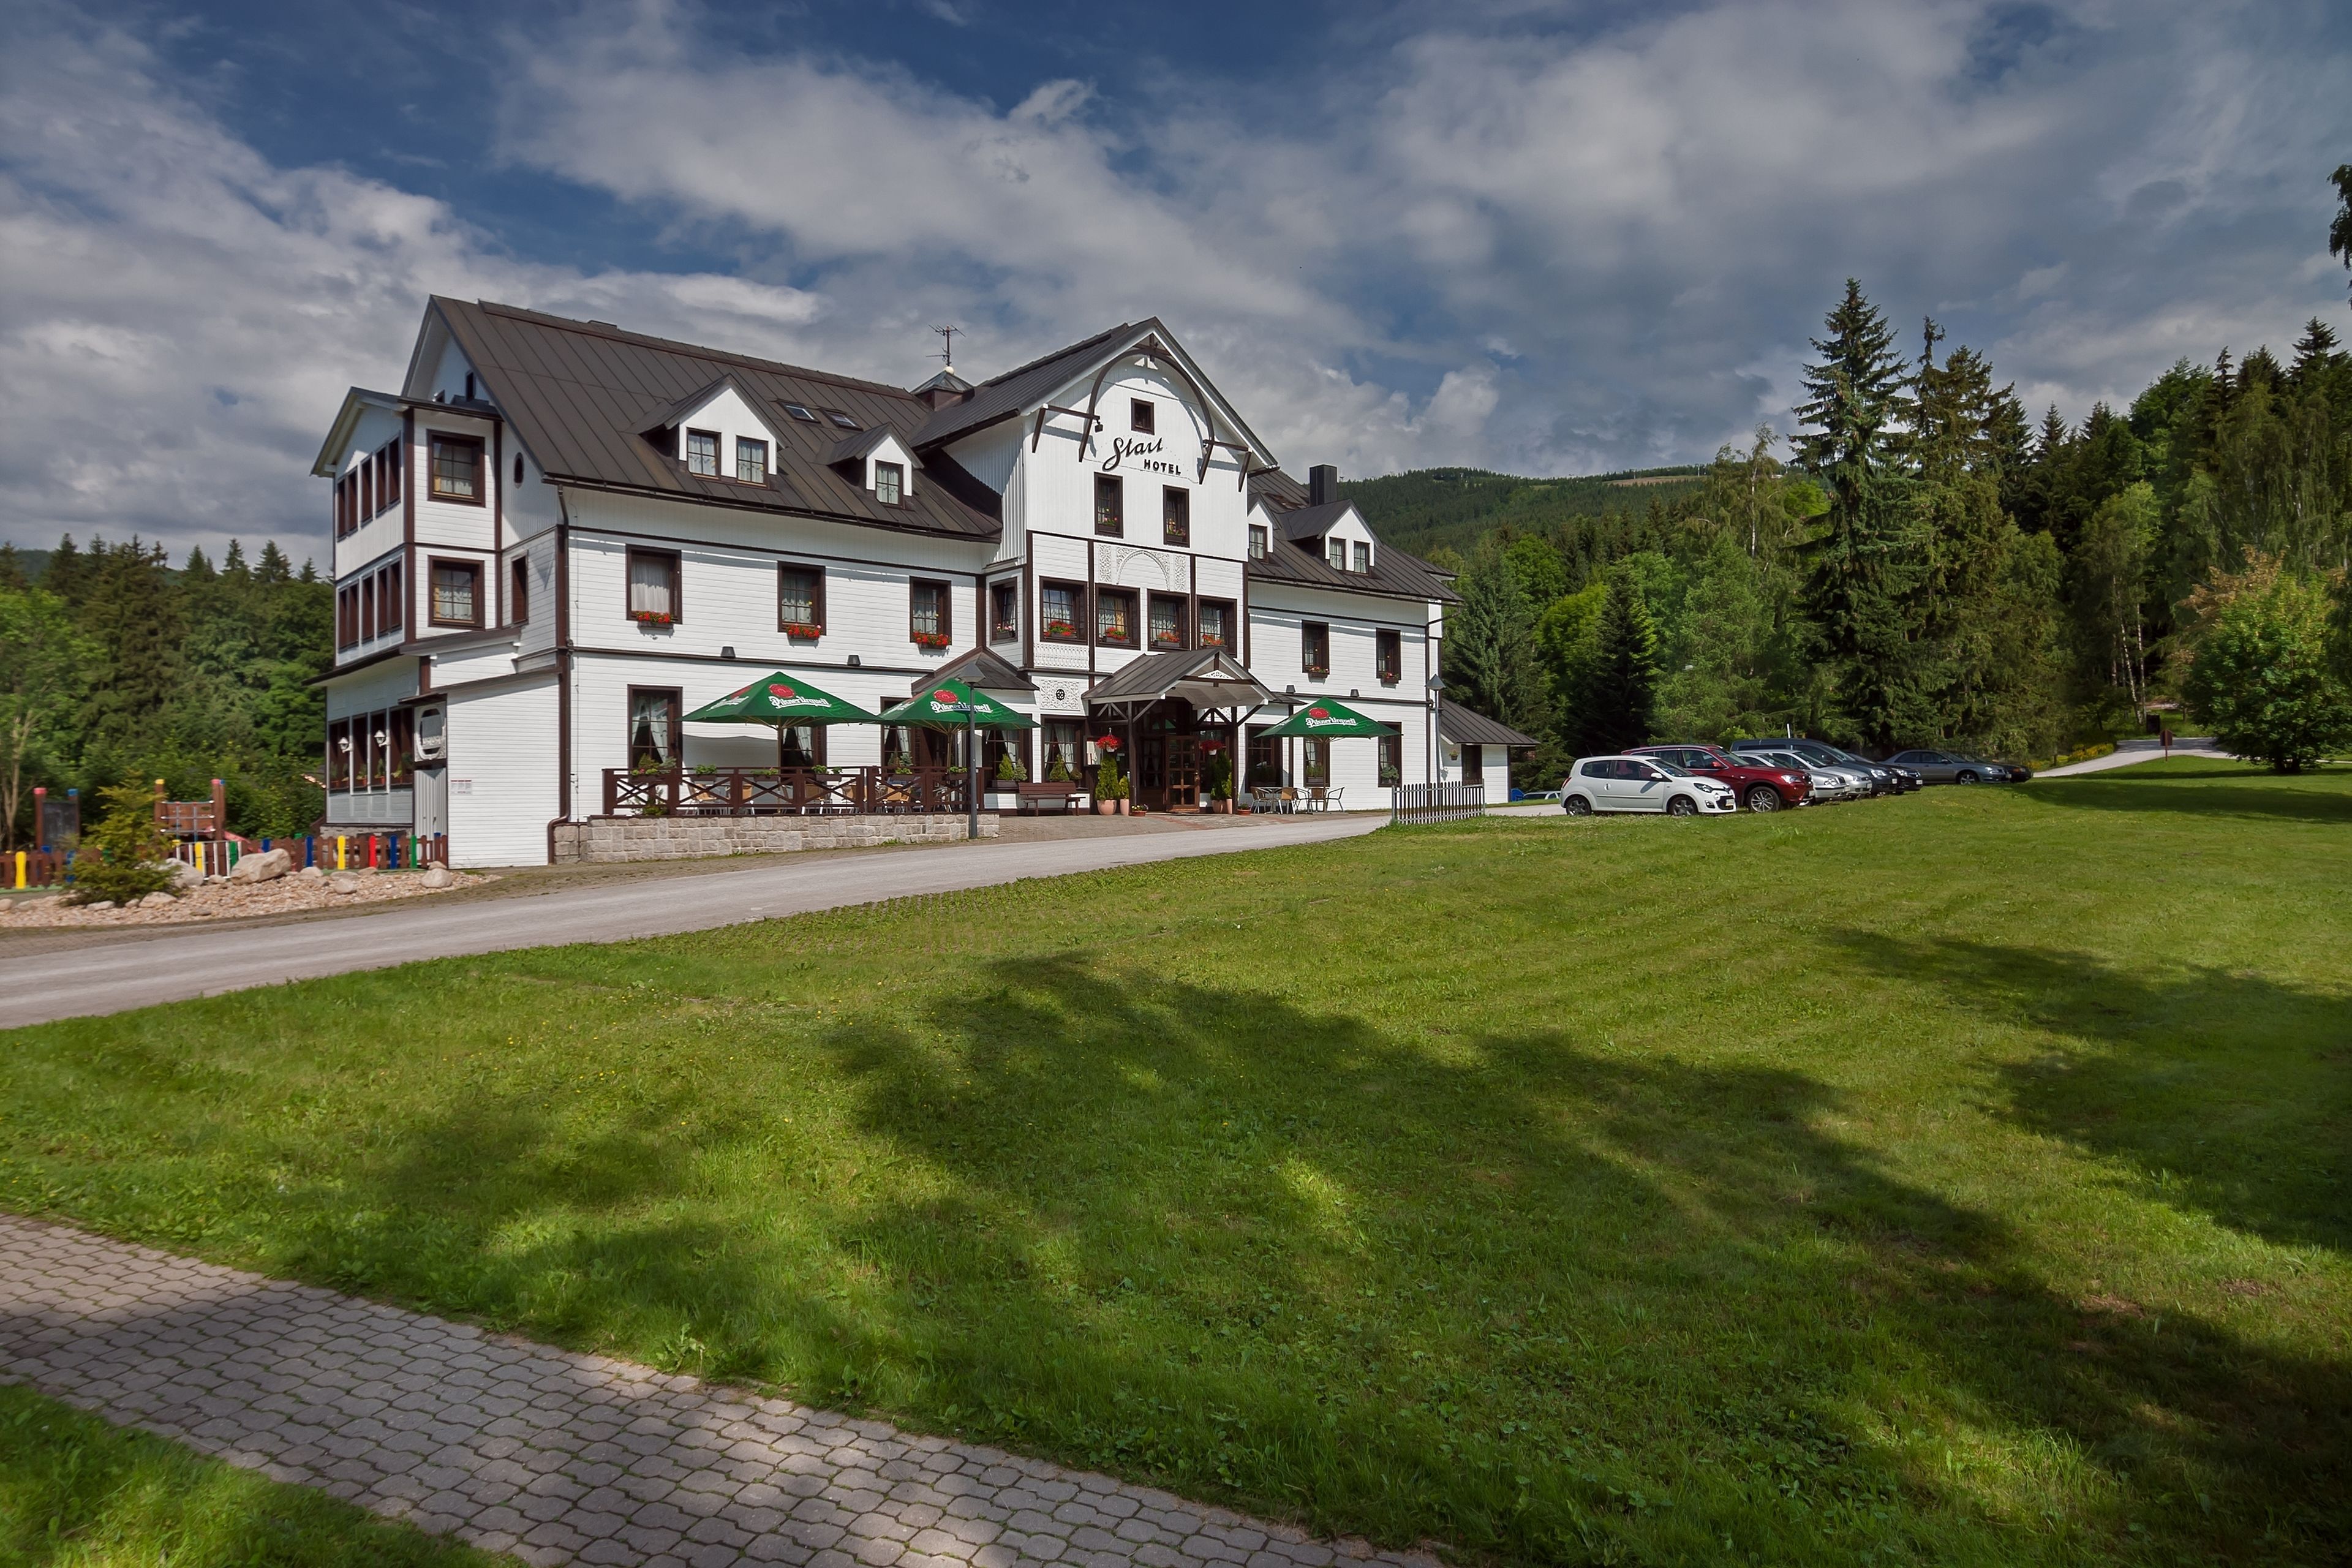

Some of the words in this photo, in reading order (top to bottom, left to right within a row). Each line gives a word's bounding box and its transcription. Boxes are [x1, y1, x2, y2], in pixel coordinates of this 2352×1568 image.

[1144, 459, 1181, 476] HOTEL
[768, 696, 799, 709] Pilsner
[796, 696, 832, 707] Urquell
[930, 701, 962, 714] Pilsner
[1305, 718, 1332, 728] Pilsner
[1329, 717, 1359, 726] Urquell
